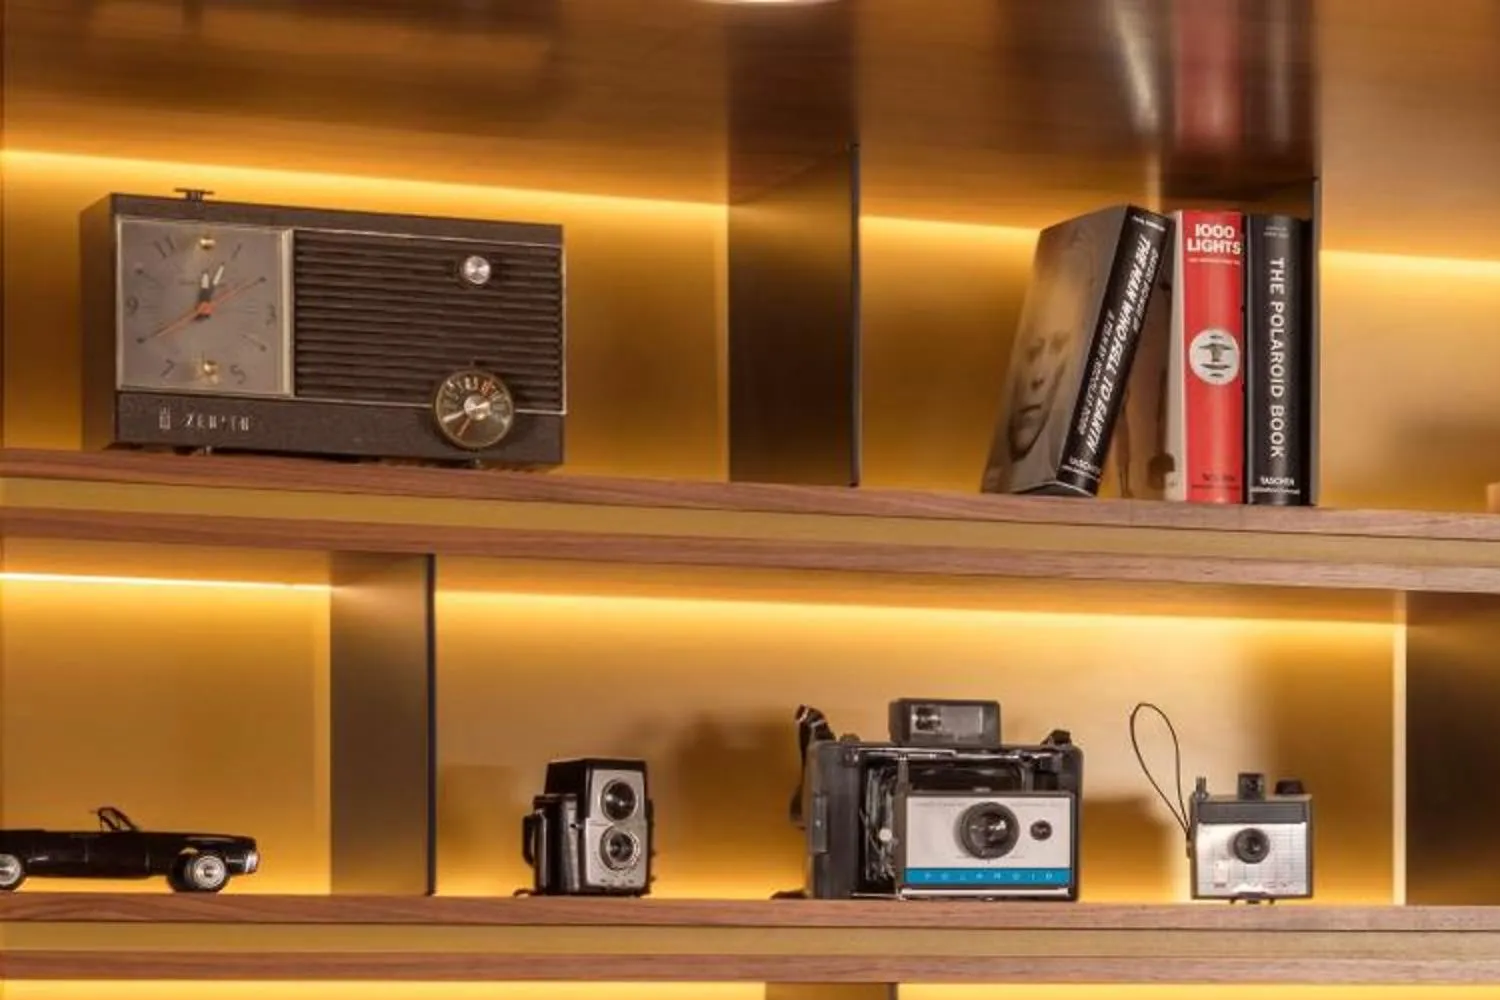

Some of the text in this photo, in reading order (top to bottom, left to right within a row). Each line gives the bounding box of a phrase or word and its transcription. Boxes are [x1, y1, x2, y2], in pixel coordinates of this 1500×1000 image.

[1187, 238, 1242, 255] LIGHTS
[1194, 223, 1236, 239] 1000
[1132, 235, 1151, 267] THE
[1124, 264, 1143, 301] MAN
[1269, 257, 1286, 295] THE
[1114, 300, 1133, 340] WHO
[1105, 337, 1125, 374] FELL
[1269, 301, 1286, 399] POLAROID
[1098, 375, 1114, 400] TO
[1085, 398, 1107, 452] EARTH
[1269, 405, 1286, 458] BOOK
